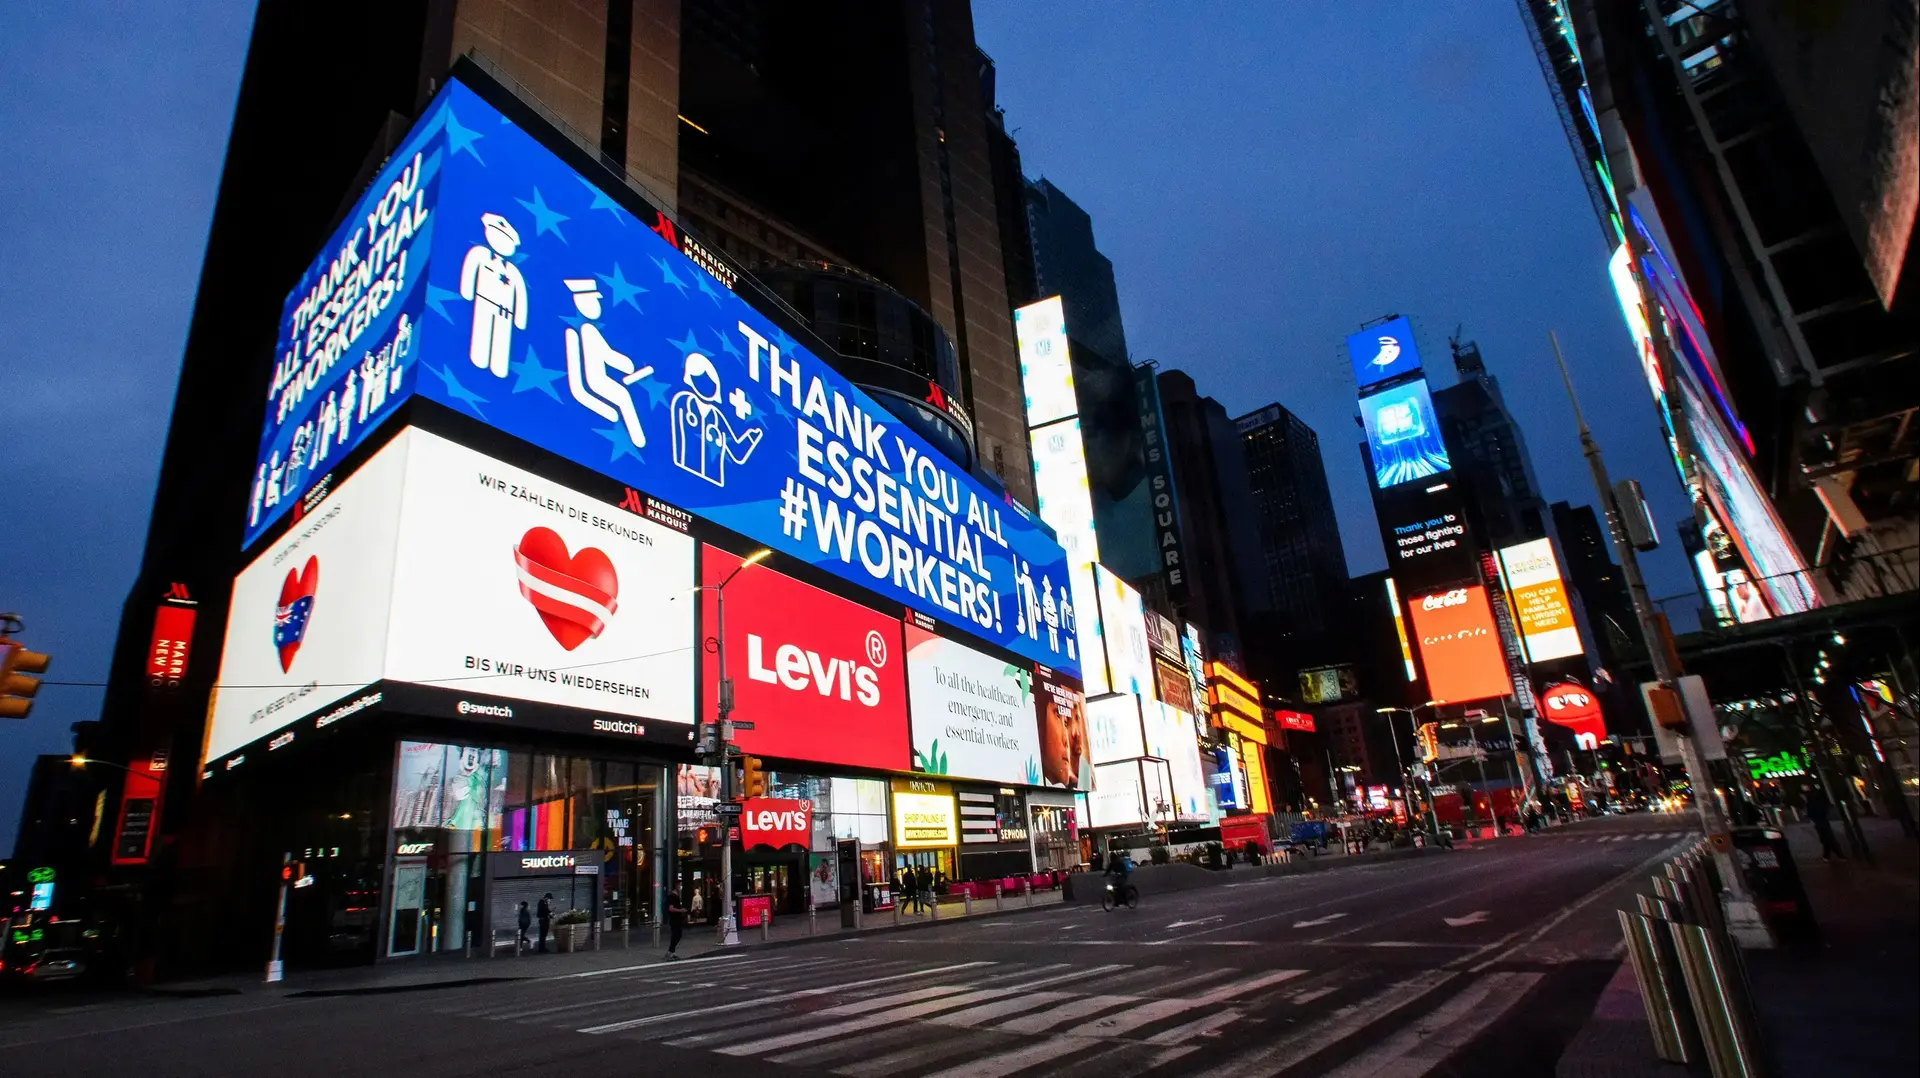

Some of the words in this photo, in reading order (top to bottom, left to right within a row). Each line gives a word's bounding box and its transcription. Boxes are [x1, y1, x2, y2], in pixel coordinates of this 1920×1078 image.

[291, 227, 364, 340] THANK
[367, 152, 422, 244] YOU
[684, 235, 738, 283] MARRIOTT
[684, 247, 733, 290] MARQUIS
[269, 340, 302, 401] ALL
[306, 189, 428, 350] ESSENTIAL
[276, 250, 408, 425] #WORKERS!
[738, 320, 891, 471] THANK
[895, 436, 959, 515] YOU
[967, 489, 1008, 549] ALL
[478, 473, 506, 492] WIR
[510, 482, 564, 515] ZÄHLEN
[568, 507, 589, 524] DIE
[592, 517, 653, 547] SEKUNDEN
[647, 498, 693, 523] MARRIOTT
[797, 418, 992, 582] ESSENTIAL
[647, 508, 688, 532] MARQUIS
[1153, 475, 1182, 585] SQUARE
[1394, 521, 1423, 535] Thank
[1425, 518, 1443, 529] you
[1443, 514, 1456, 522] to
[1397, 534, 1425, 547] those
[1425, 525, 1464, 540] fighting
[779, 476, 1003, 634] #WORKERS!
[1400, 549, 1415, 559] for
[1416, 545, 1433, 554] our
[1433, 539, 1457, 551] lives
[1538, 586, 1557, 595] CAN
[154, 639, 170, 667] NEW
[465, 656, 490, 671] BIS
[496, 661, 524, 677] WIR
[528, 668, 557, 683] UNS
[561, 674, 650, 699] WIEDERSEHEN
[933, 665, 946, 685] To
[948, 672, 960, 690] all
[960, 676, 976, 694] the
[457, 701, 512, 718] @swatch
[999, 713, 1013, 727] and
[593, 719, 640, 735] swatch
[945, 725, 985, 744] essential
[607, 809, 620, 819] NO
[608, 818, 629, 829] TIME
[614, 827, 626, 837] TO
[618, 836, 633, 846] DIE
[1000, 829, 1028, 840] SEPHORA
[522, 855, 569, 868] swatch
